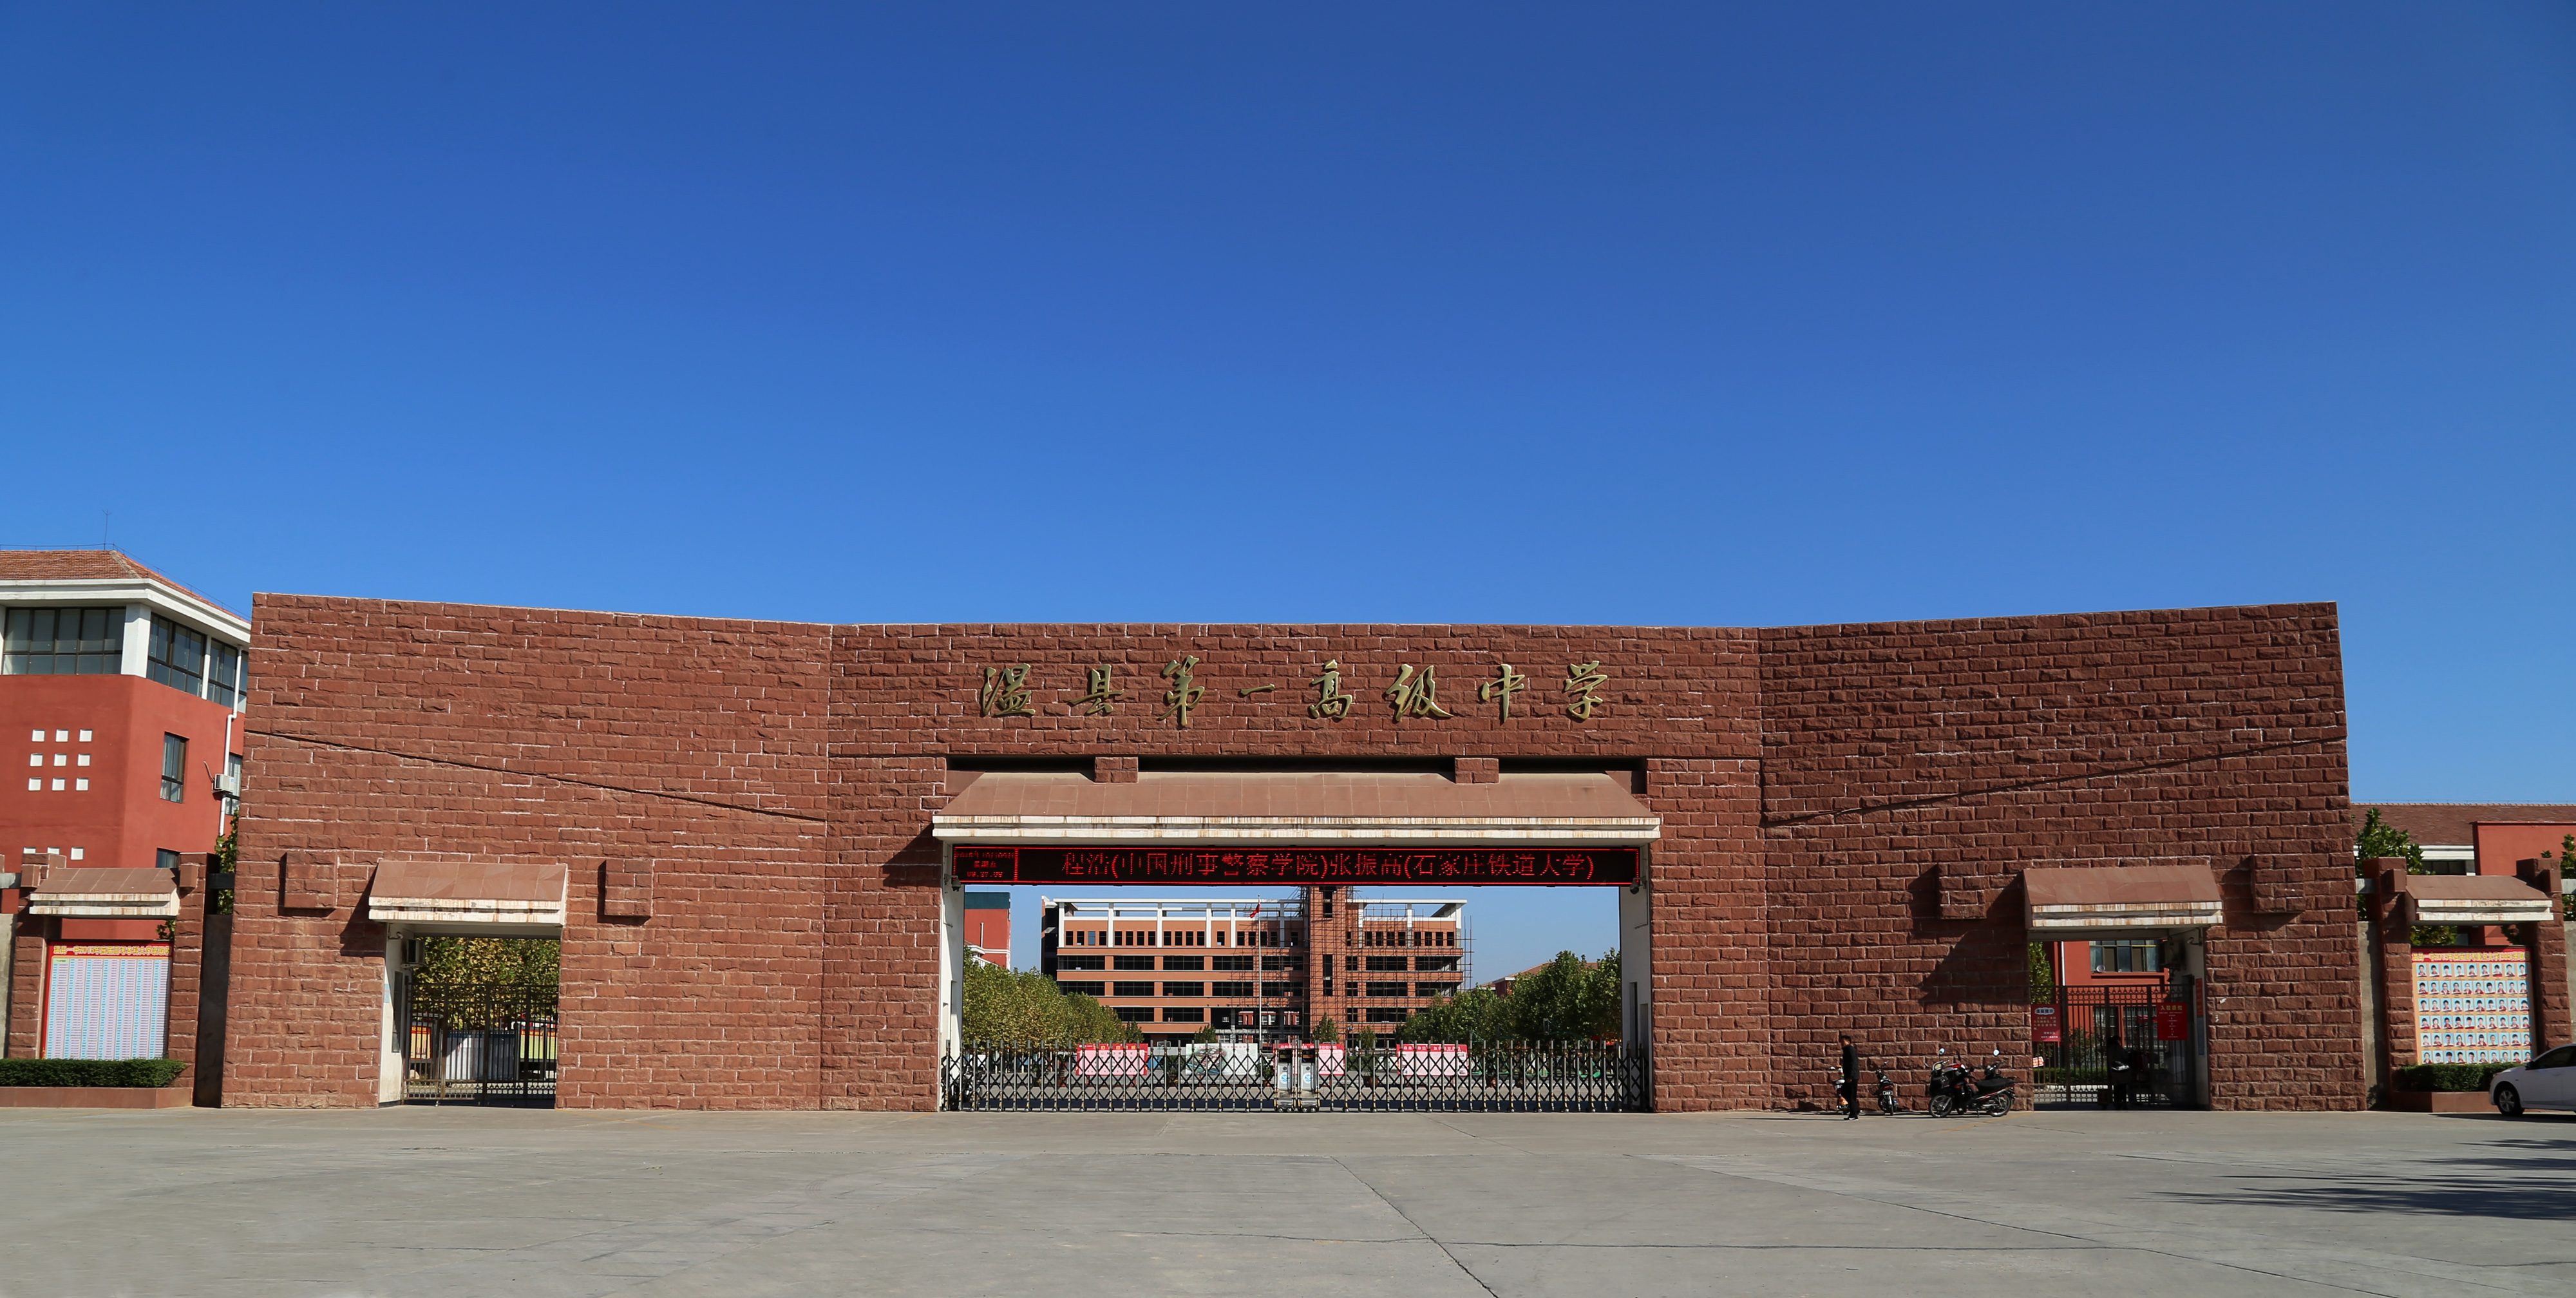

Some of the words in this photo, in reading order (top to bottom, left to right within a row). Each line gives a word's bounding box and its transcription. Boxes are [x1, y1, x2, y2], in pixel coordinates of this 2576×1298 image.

[980, 654, 1607, 727] 温县第一高级中学
